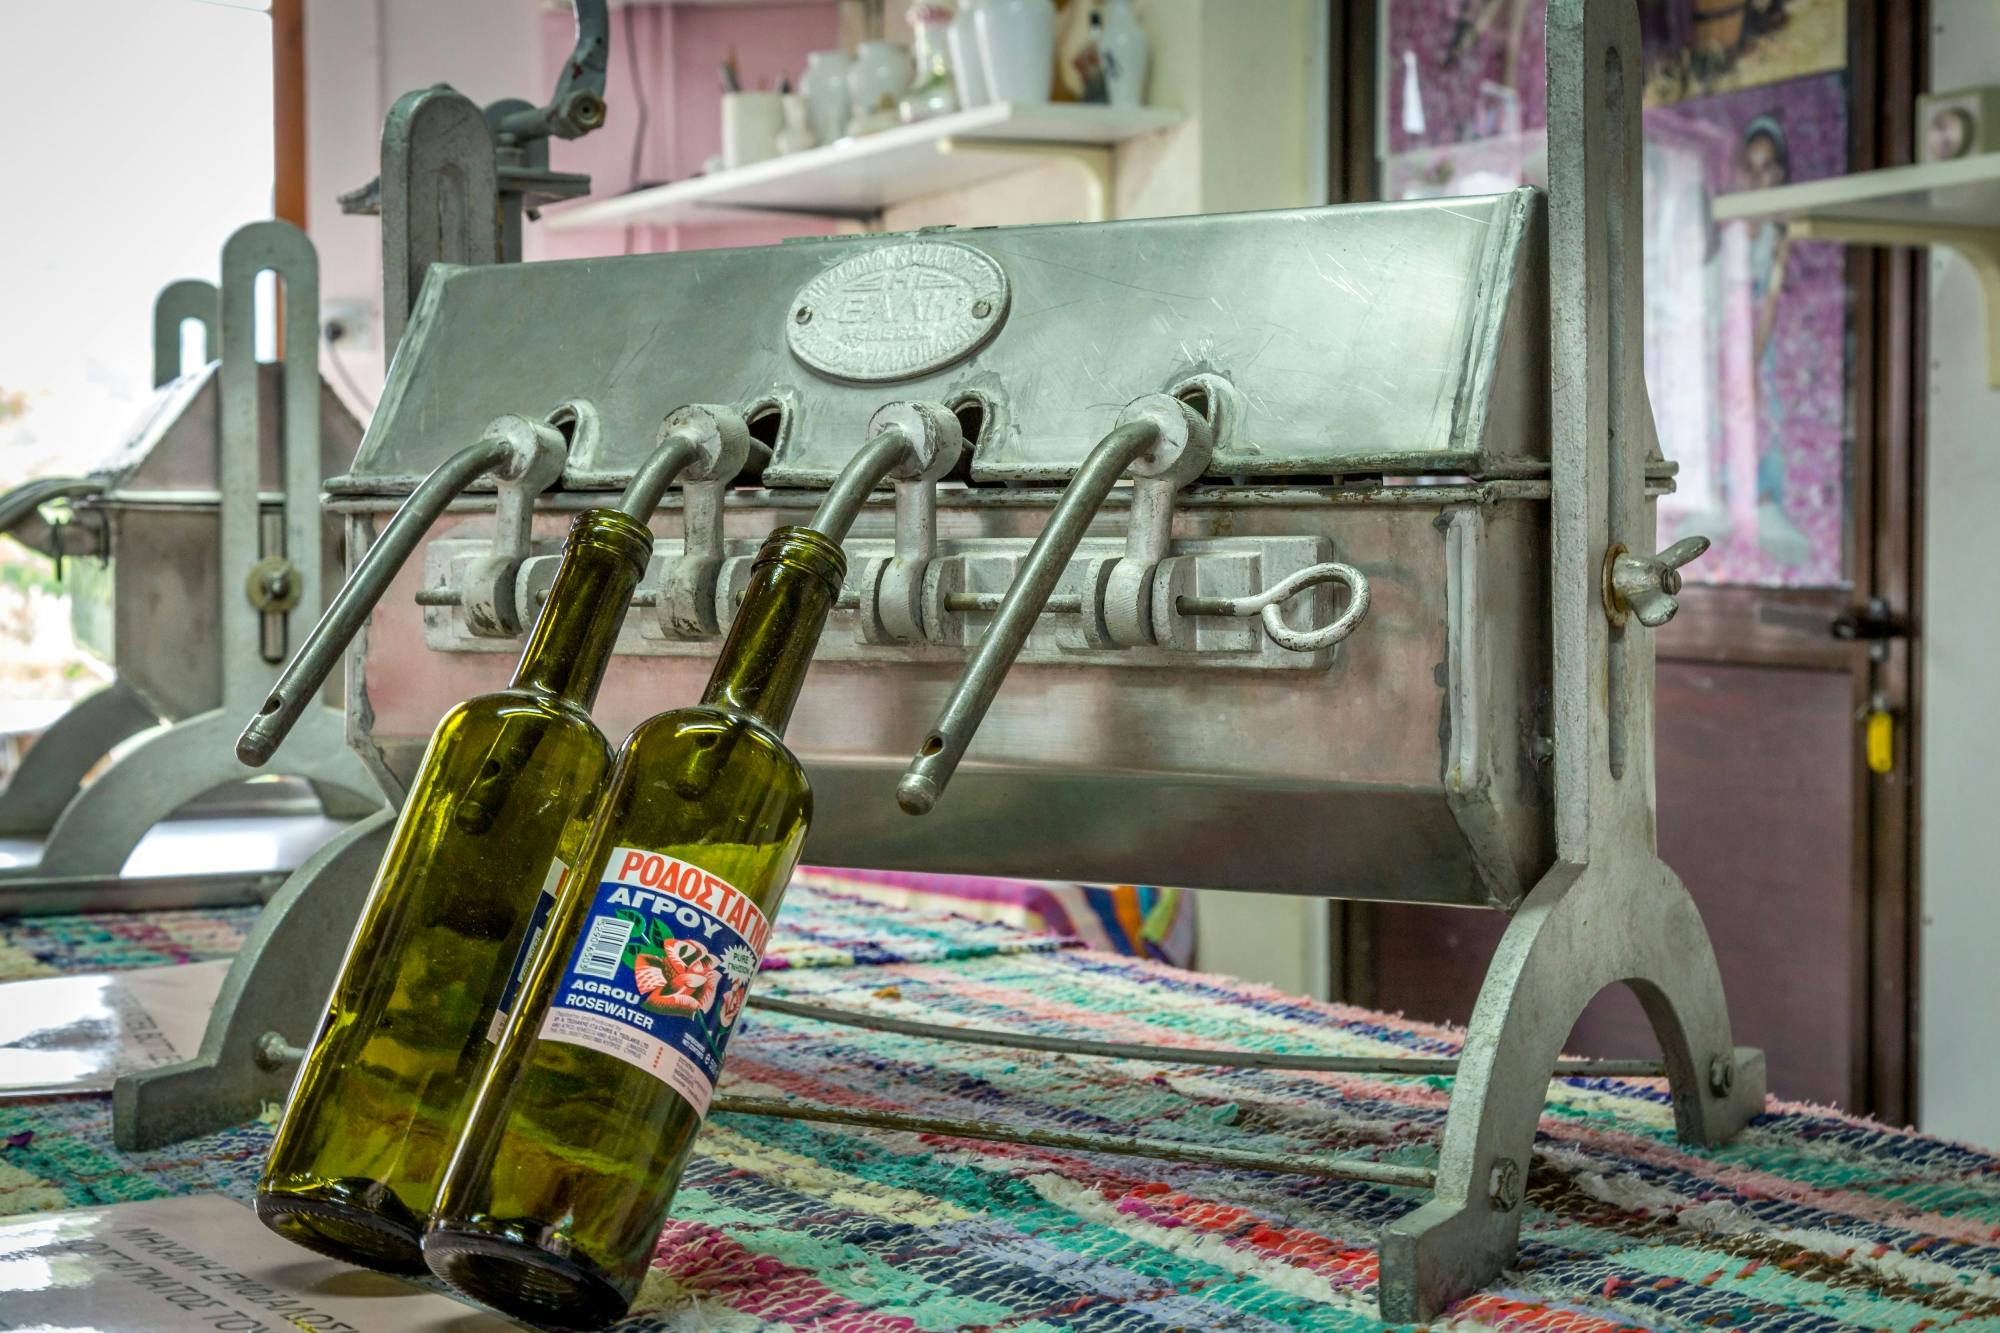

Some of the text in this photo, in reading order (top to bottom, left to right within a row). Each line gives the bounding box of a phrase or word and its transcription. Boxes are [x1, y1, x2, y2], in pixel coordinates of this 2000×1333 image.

[606, 887, 722, 939] ΑΓΡΟΥ
[618, 850, 769, 957] ΡΟΔΟΣΤΑΓΜ
[565, 993, 654, 1031] ROSEWATER
[570, 978, 641, 1005] AGROU
[58, 1239, 230, 1312] ΟΣΤΑΓΜΑΤΟΣ
[112, 1227, 362, 1333] ΜΗΧΑΝΗ ΕΜΦΙΑΛΩΣ
